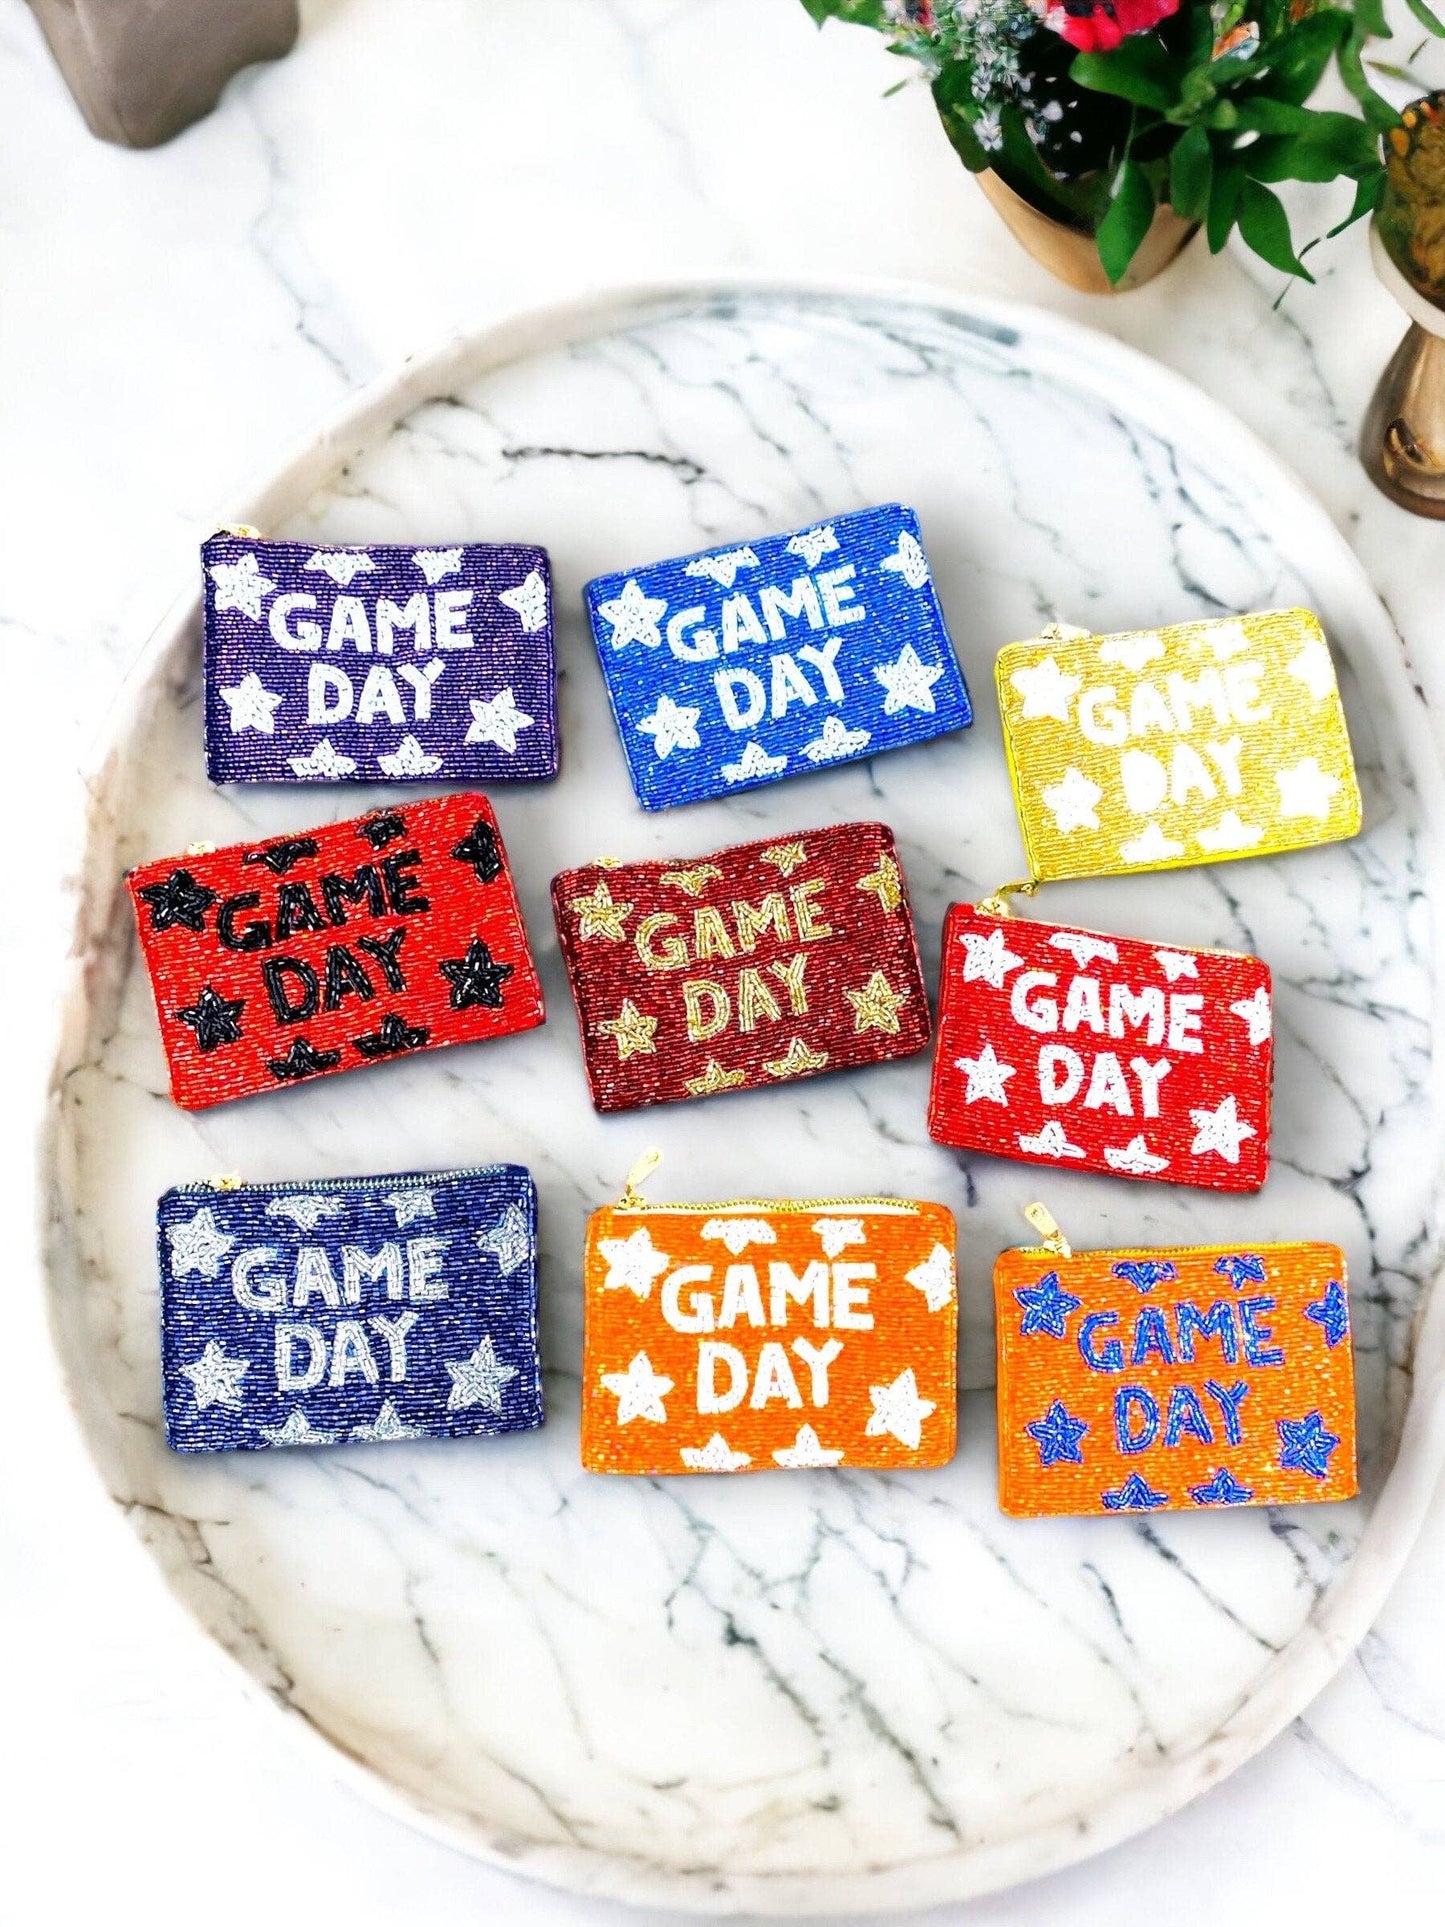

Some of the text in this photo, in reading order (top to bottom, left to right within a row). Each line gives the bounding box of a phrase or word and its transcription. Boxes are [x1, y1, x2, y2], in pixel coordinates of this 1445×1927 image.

[269, 590, 475, 654] GAME
[666, 565, 866, 662] GAME
[306, 657, 447, 726] DAY
[713, 636, 843, 731] DAY
[1077, 660, 1271, 746] GAME
[1119, 736, 1244, 814] DAY
[217, 848, 430, 953] GAME
[633, 880, 832, 970] GAME
[262, 929, 406, 1024] DAY
[682, 952, 809, 1042] DAY
[1010, 970, 1204, 1054] GAME
[1037, 1044, 1172, 1119] DAY
[231, 1237, 451, 1313] GAME
[660, 1261, 877, 1334] GAME
[274, 1310, 418, 1392] DAY
[1077, 1295, 1285, 1374] GAME
[697, 1336, 845, 1415] DAY
[1114, 1378, 1249, 1455] DAY
